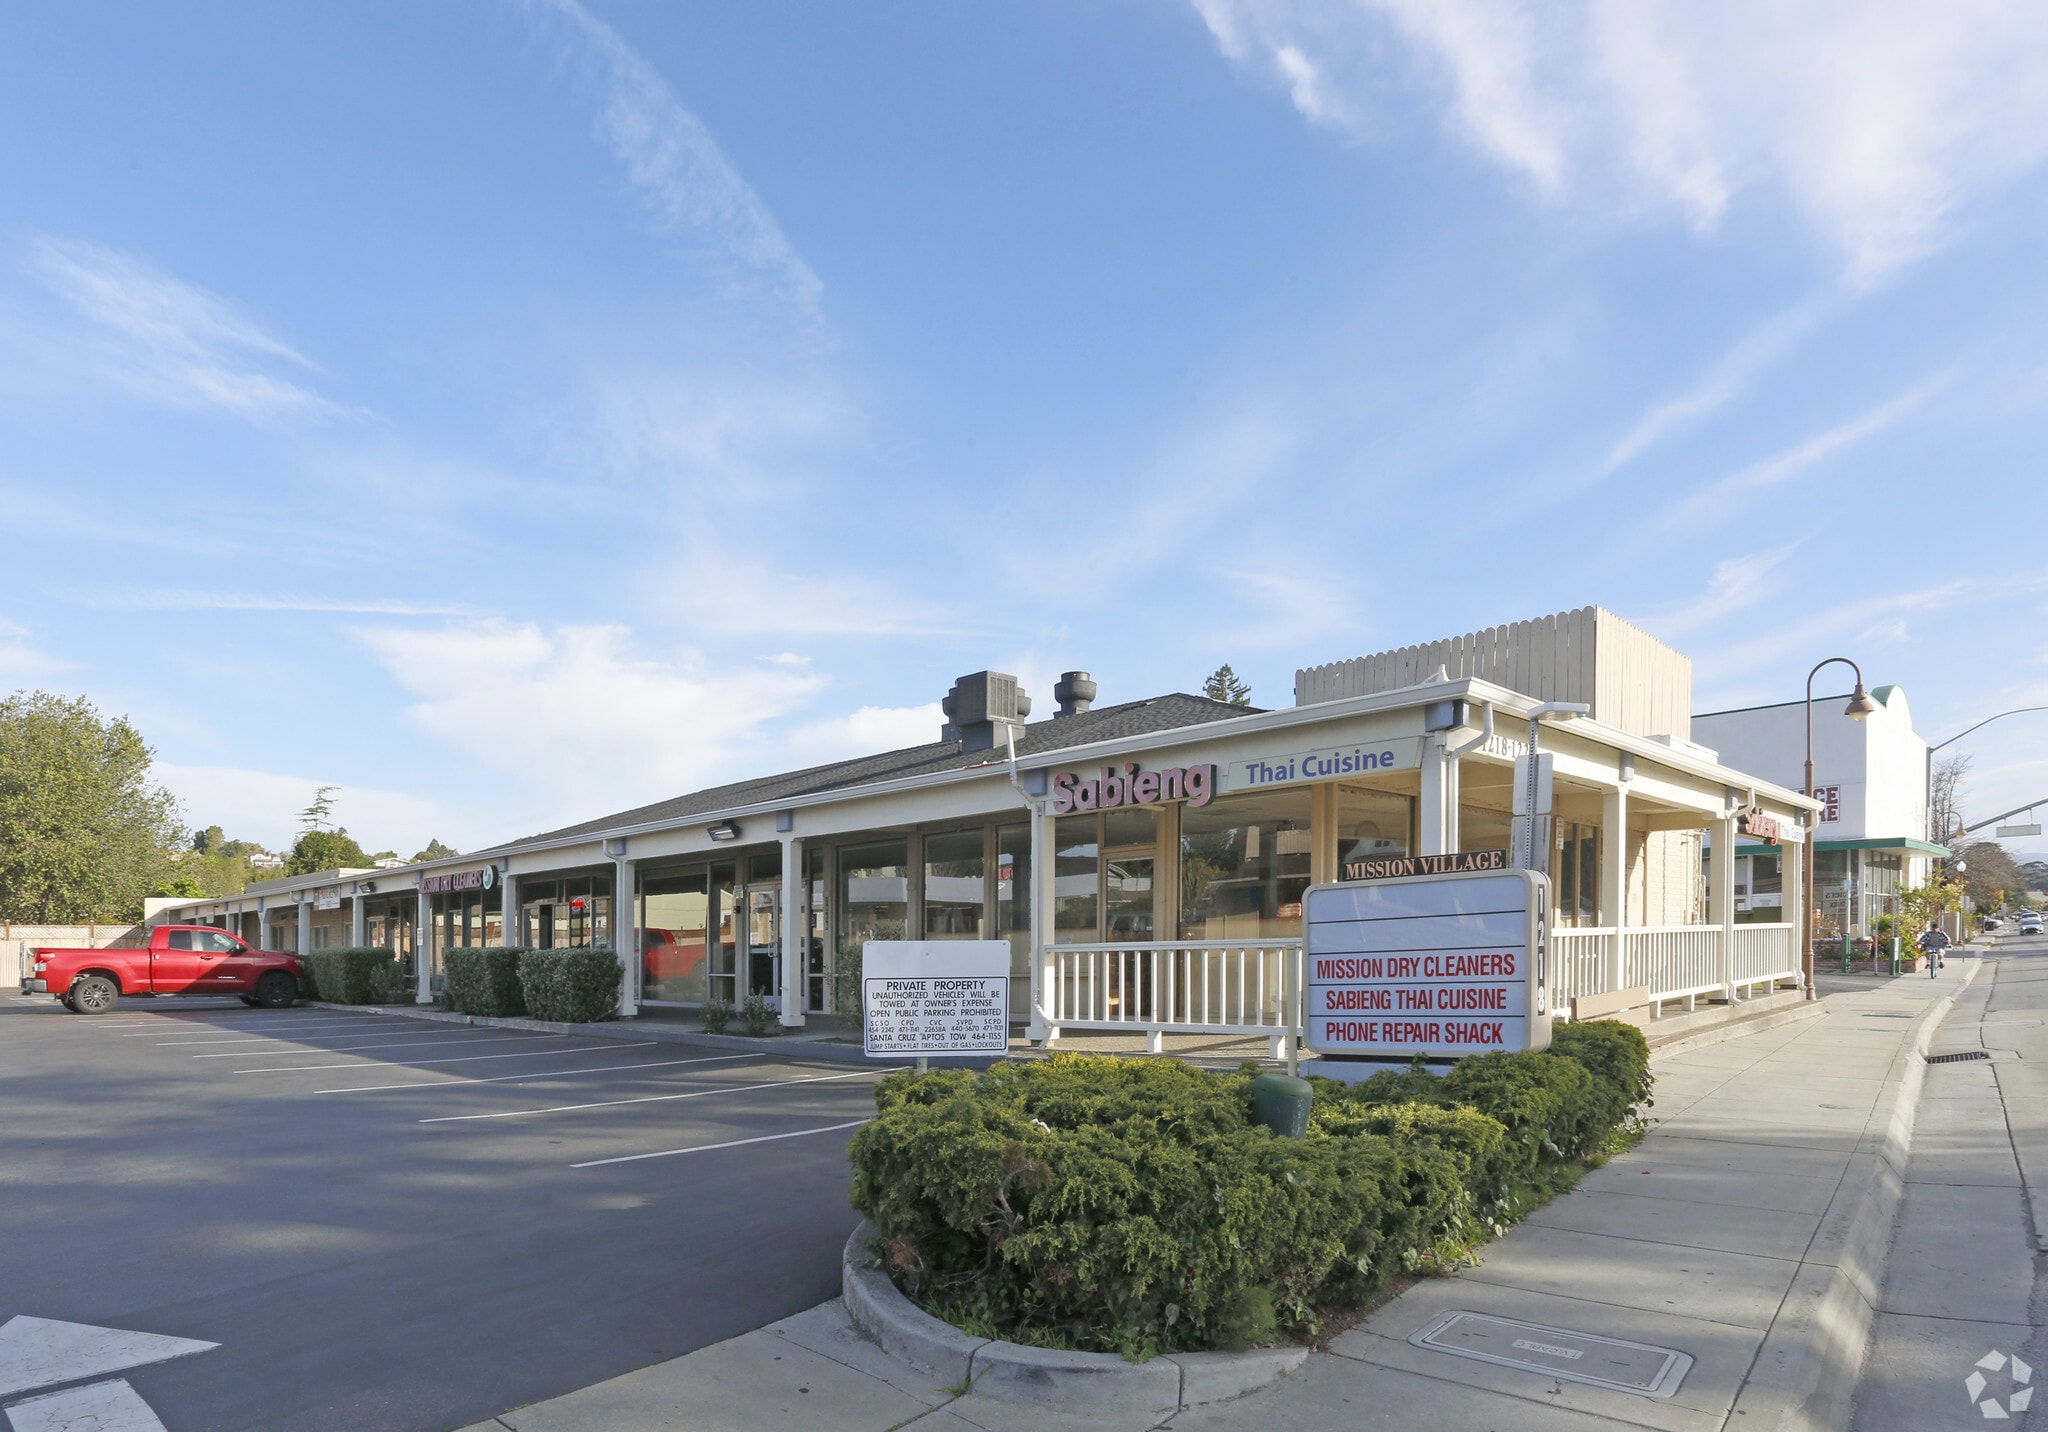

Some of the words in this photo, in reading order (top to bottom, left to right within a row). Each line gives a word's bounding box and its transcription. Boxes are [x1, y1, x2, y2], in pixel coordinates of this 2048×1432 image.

[1246, 759, 1295, 785] Thai
[1302, 749, 1395, 778] Cuisine
[1053, 763, 1217, 813] Sabieng
[1345, 859, 1416, 880] MISSION
[1418, 851, 1503, 874] VILLAGE
[1317, 958, 1383, 979] MISSION
[1387, 956, 1421, 978] DRY
[1424, 953, 1516, 977] CLEANERS
[872, 991, 928, 999] UNAUTHORIZED
[886, 981, 926, 990] PRIVATE
[934, 980, 985, 990] PROPERTY
[880, 1000, 906, 1008] TOWED
[1326, 989, 1391, 1010] SABIENG
[1395, 989, 1433, 1010] THAI
[1438, 988, 1507, 1010] CUISINE
[895, 1009, 919, 1017] PUBLIC
[960, 1008, 1002, 1016] PROHIBITED
[1326, 1022, 1378, 1042] PHONE
[1382, 1022, 1440, 1043] REPAIR
[1445, 1022, 1504, 1044] SHACK
